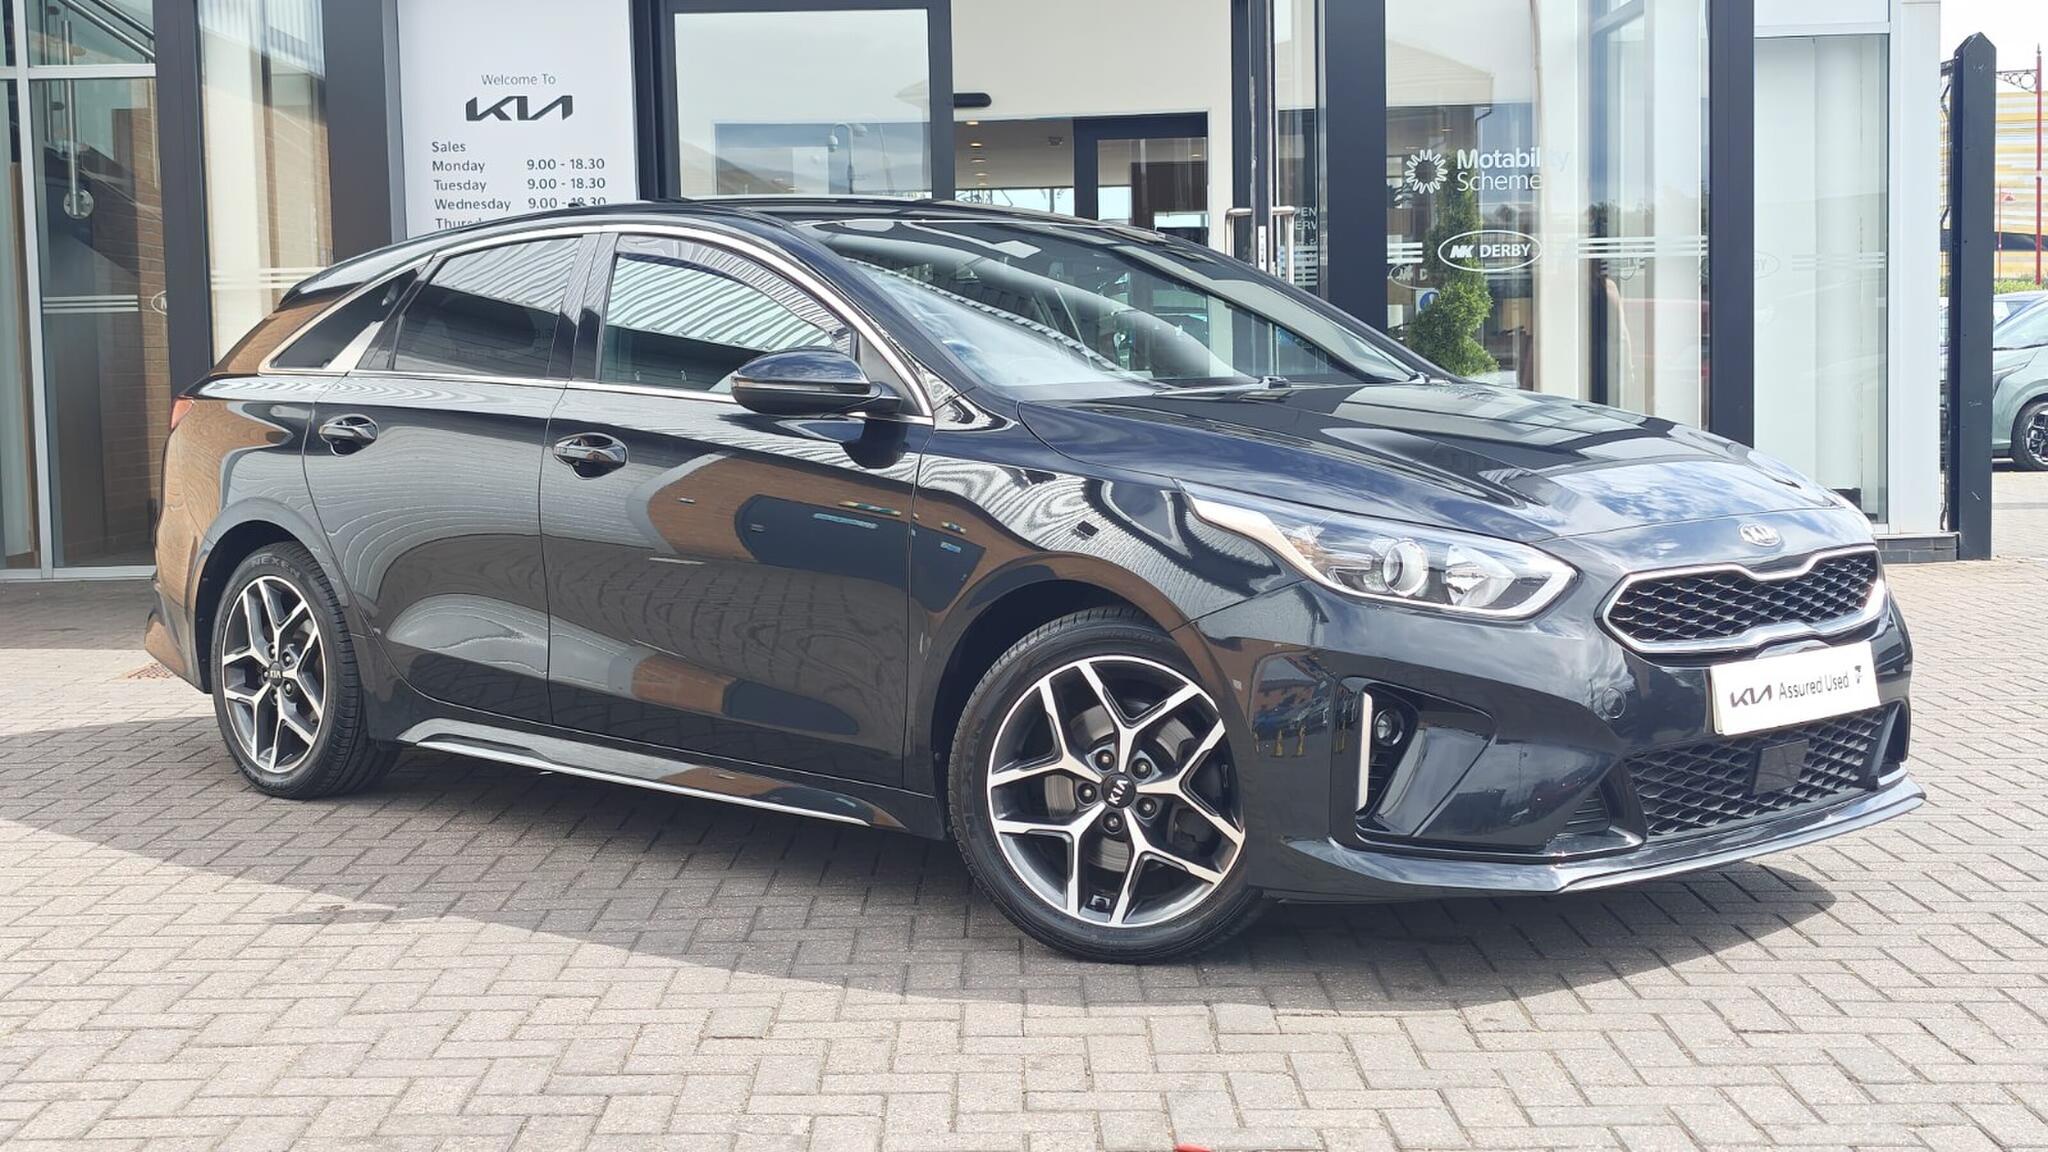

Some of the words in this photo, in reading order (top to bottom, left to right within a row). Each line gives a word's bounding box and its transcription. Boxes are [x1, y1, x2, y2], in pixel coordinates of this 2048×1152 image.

[481, 73, 538, 86] Welcome
[542, 73, 557, 85] To
[465, 94, 574, 121] KIA
[431, 140, 467, 153] Sales
[431, 160, 486, 173] Monday
[526, 158, 557, 171] 9.00
[569, 157, 606, 170] 18.30
[433, 178, 488, 192] Tuesday
[526, 177, 558, 190] 9.00
[570, 176, 607, 189] 18.30
[1456, 171, 1544, 192] Scheme
[434, 197, 512, 212] Wednesday
[527, 197, 558, 209] 9.00
[1479, 243, 1532, 258] DERBY
[1729, 684, 1773, 708] KIA
[1778, 675, 1824, 700] Assured
[1824, 672, 1850, 692] Used
[1108, 779, 1129, 806] KIA
